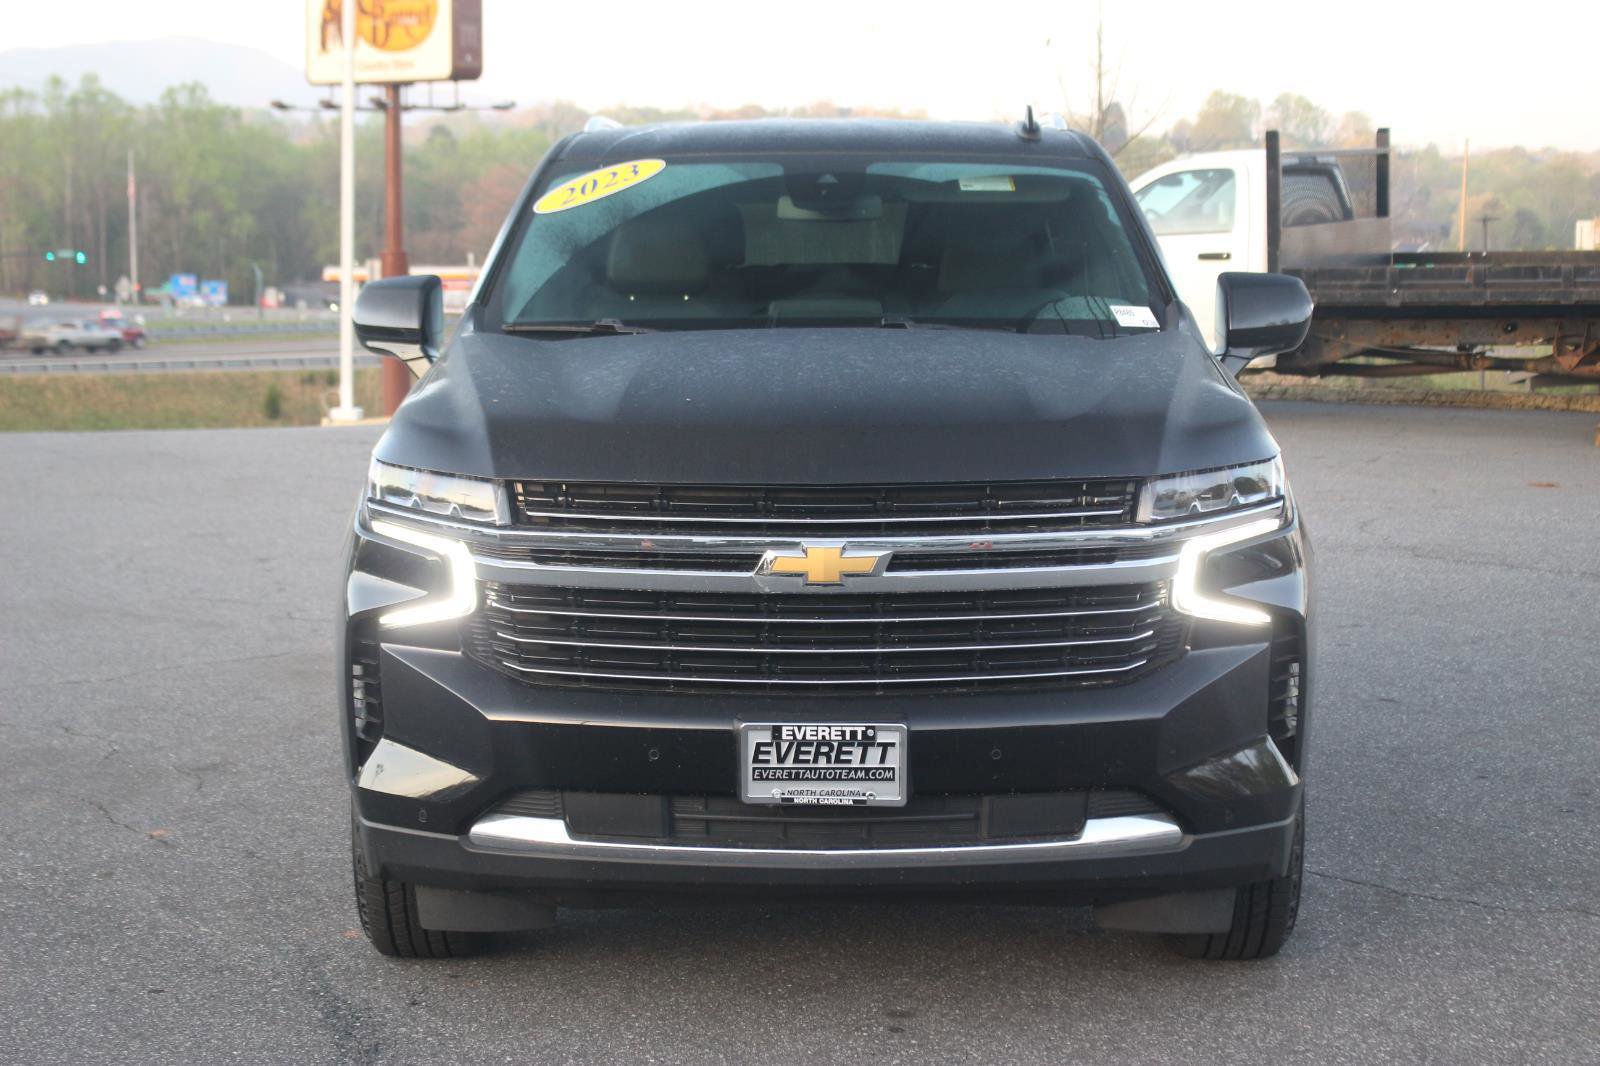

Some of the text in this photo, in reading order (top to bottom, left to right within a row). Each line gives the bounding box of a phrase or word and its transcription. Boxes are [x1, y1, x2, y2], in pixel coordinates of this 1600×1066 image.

[561, 164, 639, 206] 2023
[781, 726, 866, 740] EVERETT
[752, 742, 896, 764] EVERETT
[753, 769, 893, 779] EVERETTAUTOTEAM.COM
[787, 789, 861, 797] NORTH CAROLINA
